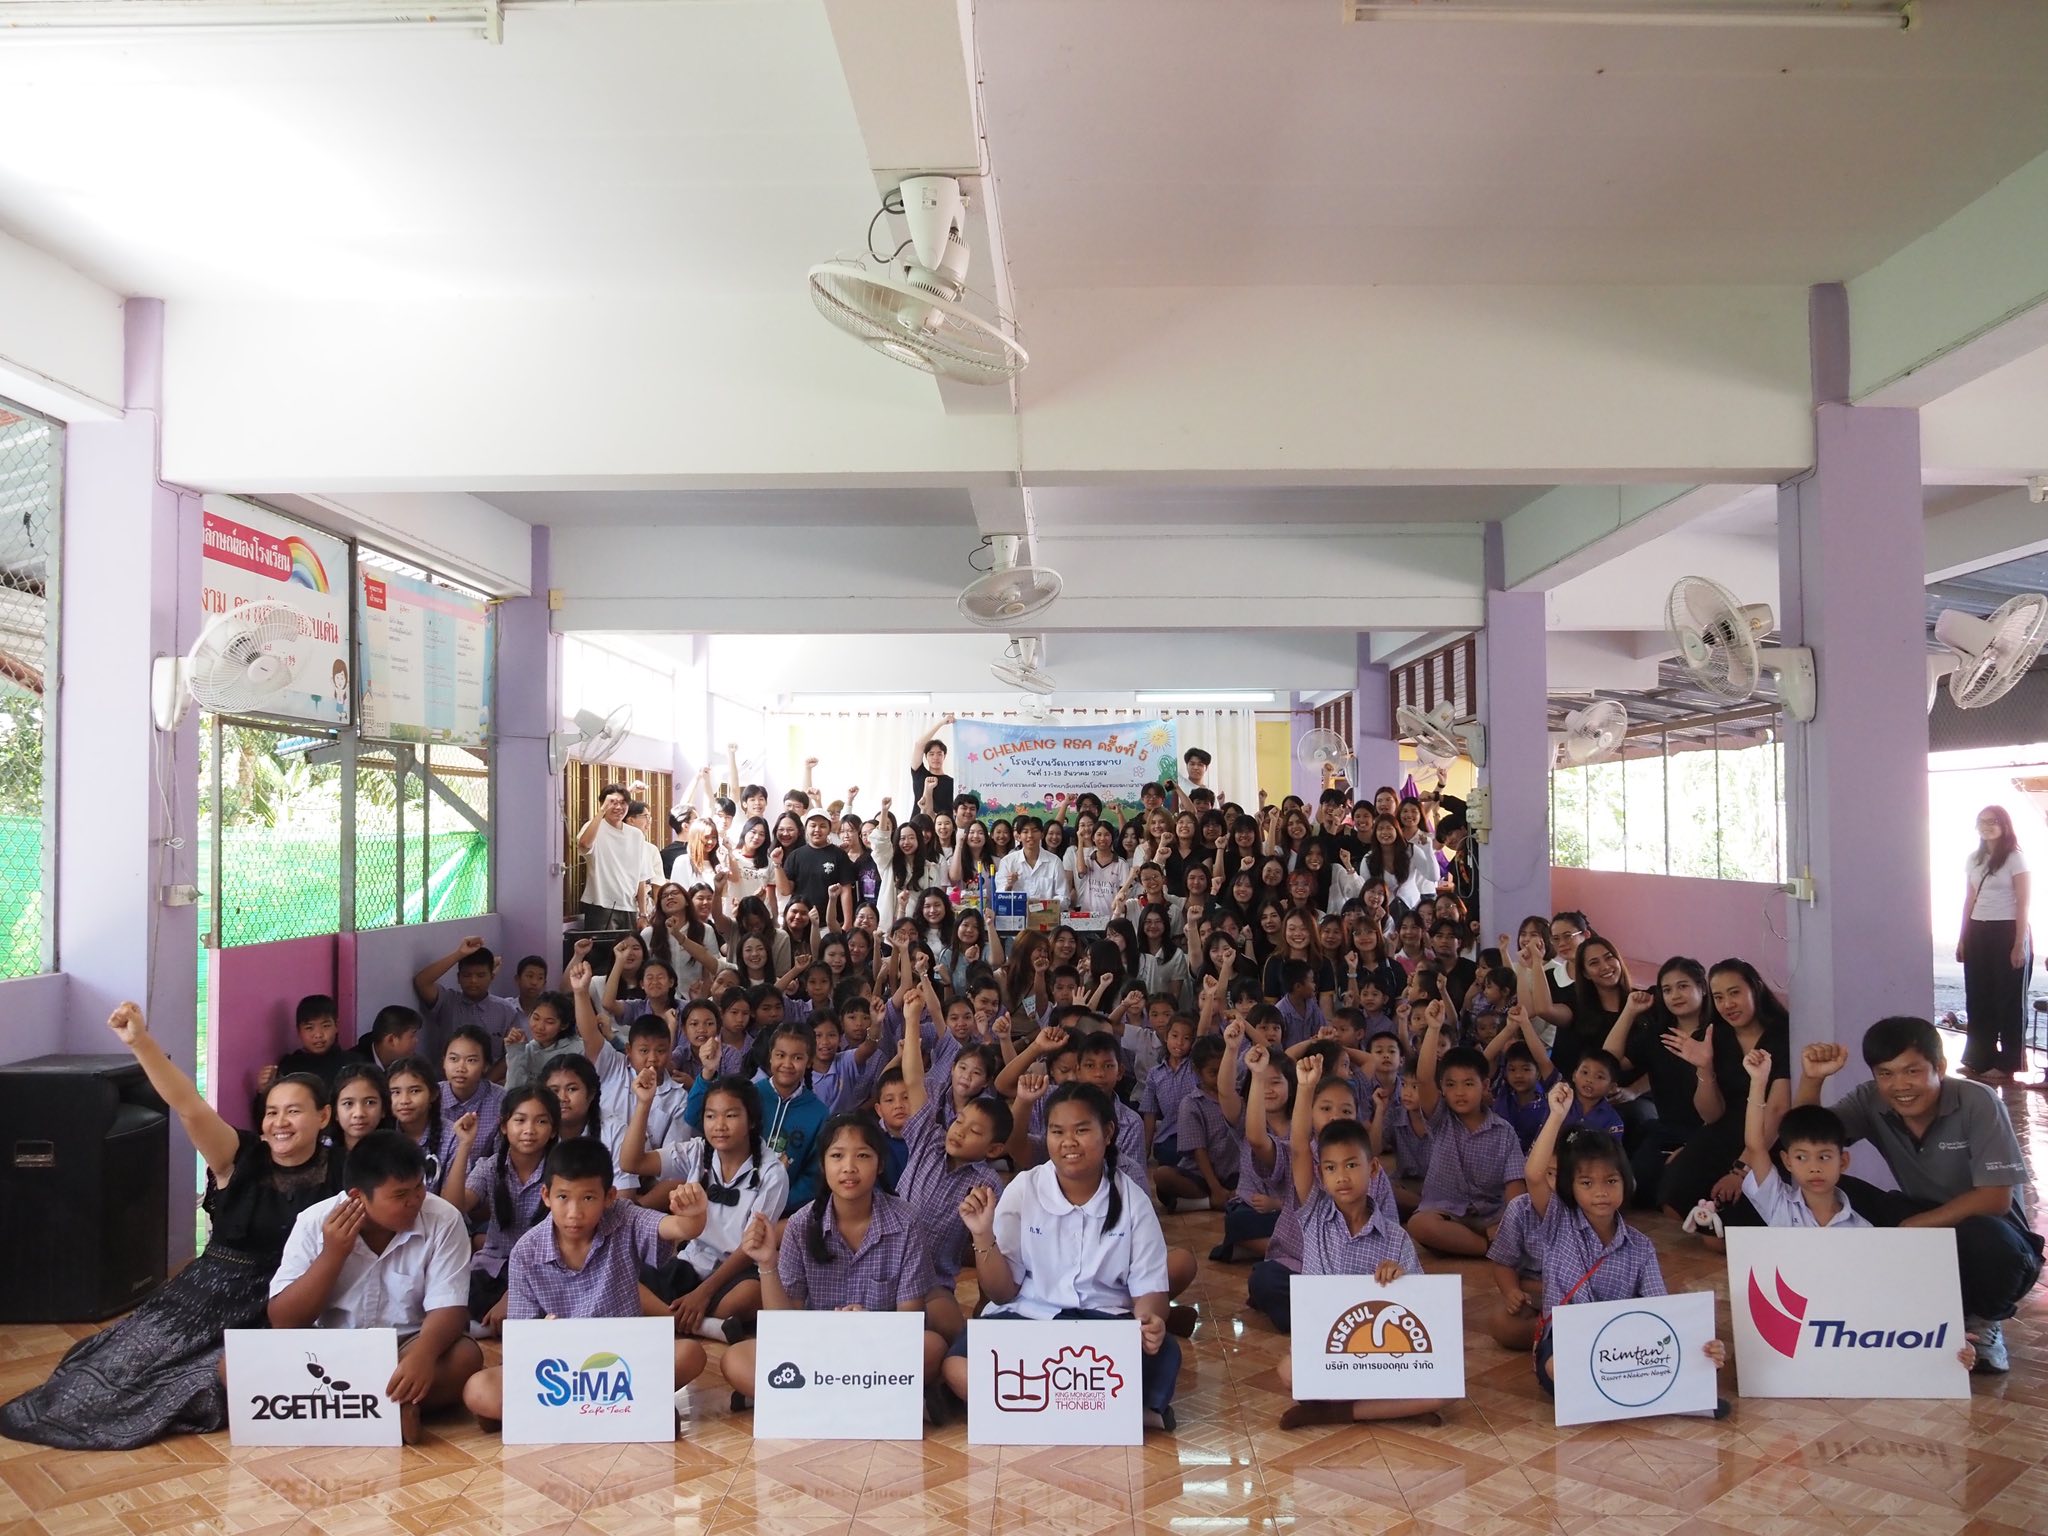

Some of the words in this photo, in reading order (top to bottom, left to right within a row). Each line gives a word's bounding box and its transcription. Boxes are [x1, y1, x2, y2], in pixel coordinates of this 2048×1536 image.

[202, 520, 291, 572] ลักษณ์ของโรงเรียน
[982, 738, 1057, 761] CHEMENG
[1063, 738, 1092, 750] RSA
[1097, 734, 1138, 757] ครั้งที่
[1138, 748, 1149, 762] 5
[1329, 1305, 1374, 1353] USEFUL
[1599, 1345, 1662, 1363] Rimtan
[1636, 1354, 1672, 1366] Resort
[1325, 1360, 1349, 1371] บริษัท
[1352, 1361, 1409, 1372] อาหารยอดคุณ
[1412, 1360, 1434, 1371] จำกัด
[535, 1358, 634, 1407] SiMA
[814, 1370, 915, 1389] be-engineer
[1052, 1366, 1106, 1391] ChE
[1055, 1391, 1069, 1399] KING
[1070, 1391, 1106, 1399] MONGKUT'S
[251, 1394, 382, 1420] 2GETHER
[579, 1404, 605, 1416] Safe
[607, 1405, 632, 1414] Tech
[1055, 1400, 1106, 1411] THONBURI
